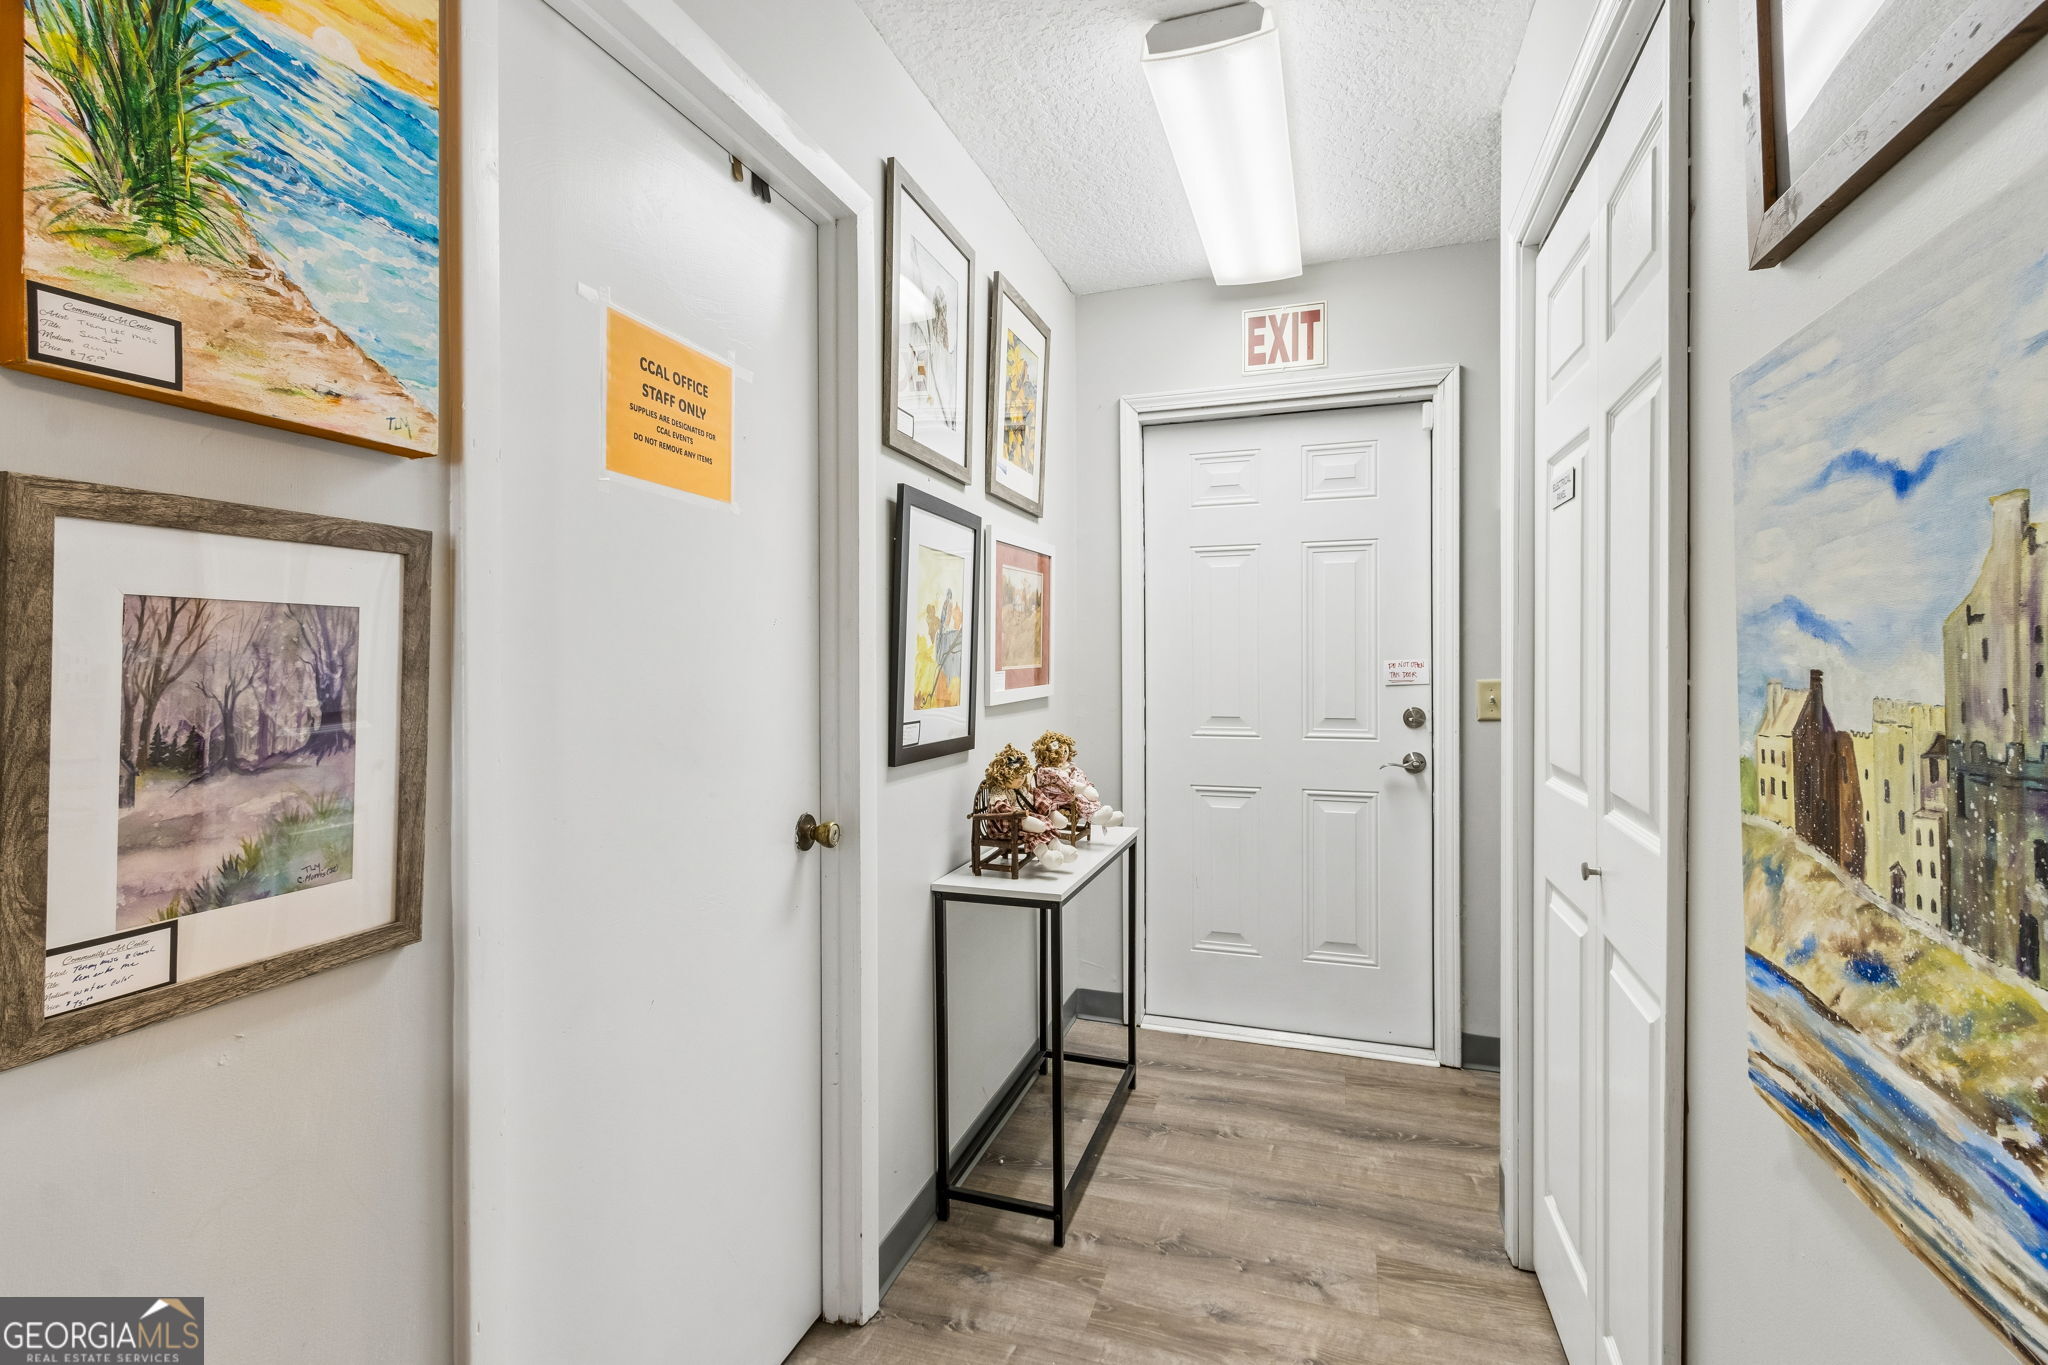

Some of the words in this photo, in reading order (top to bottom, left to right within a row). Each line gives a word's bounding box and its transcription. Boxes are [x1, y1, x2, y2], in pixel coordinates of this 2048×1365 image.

[62, 302, 107, 321] Community
[128, 319, 153, 331] Center
[1247, 309, 1321, 366] EXIT
[639, 356, 670, 382] CCAL
[672, 371, 709, 398] OFFICE
[642, 383, 676, 408] STAFF
[678, 398, 707, 421] ONLY
[629, 402, 658, 420] SUPPLIES
[658, 414, 671, 425] ARE
[671, 418, 705, 437] DESIGNATED
[705, 433, 716, 441] FOR
[656, 425, 671, 438] CCAL
[672, 430, 694, 445] EVENTS
[633, 431, 643, 442] DO
[644, 436, 658, 447] NOT
[658, 441, 684, 456] REMOVE
[683, 448, 696, 460] ANY
[697, 453, 713, 465] ITEMS
[62, 950, 106, 966] Community
[126, 939, 151, 951] Center
